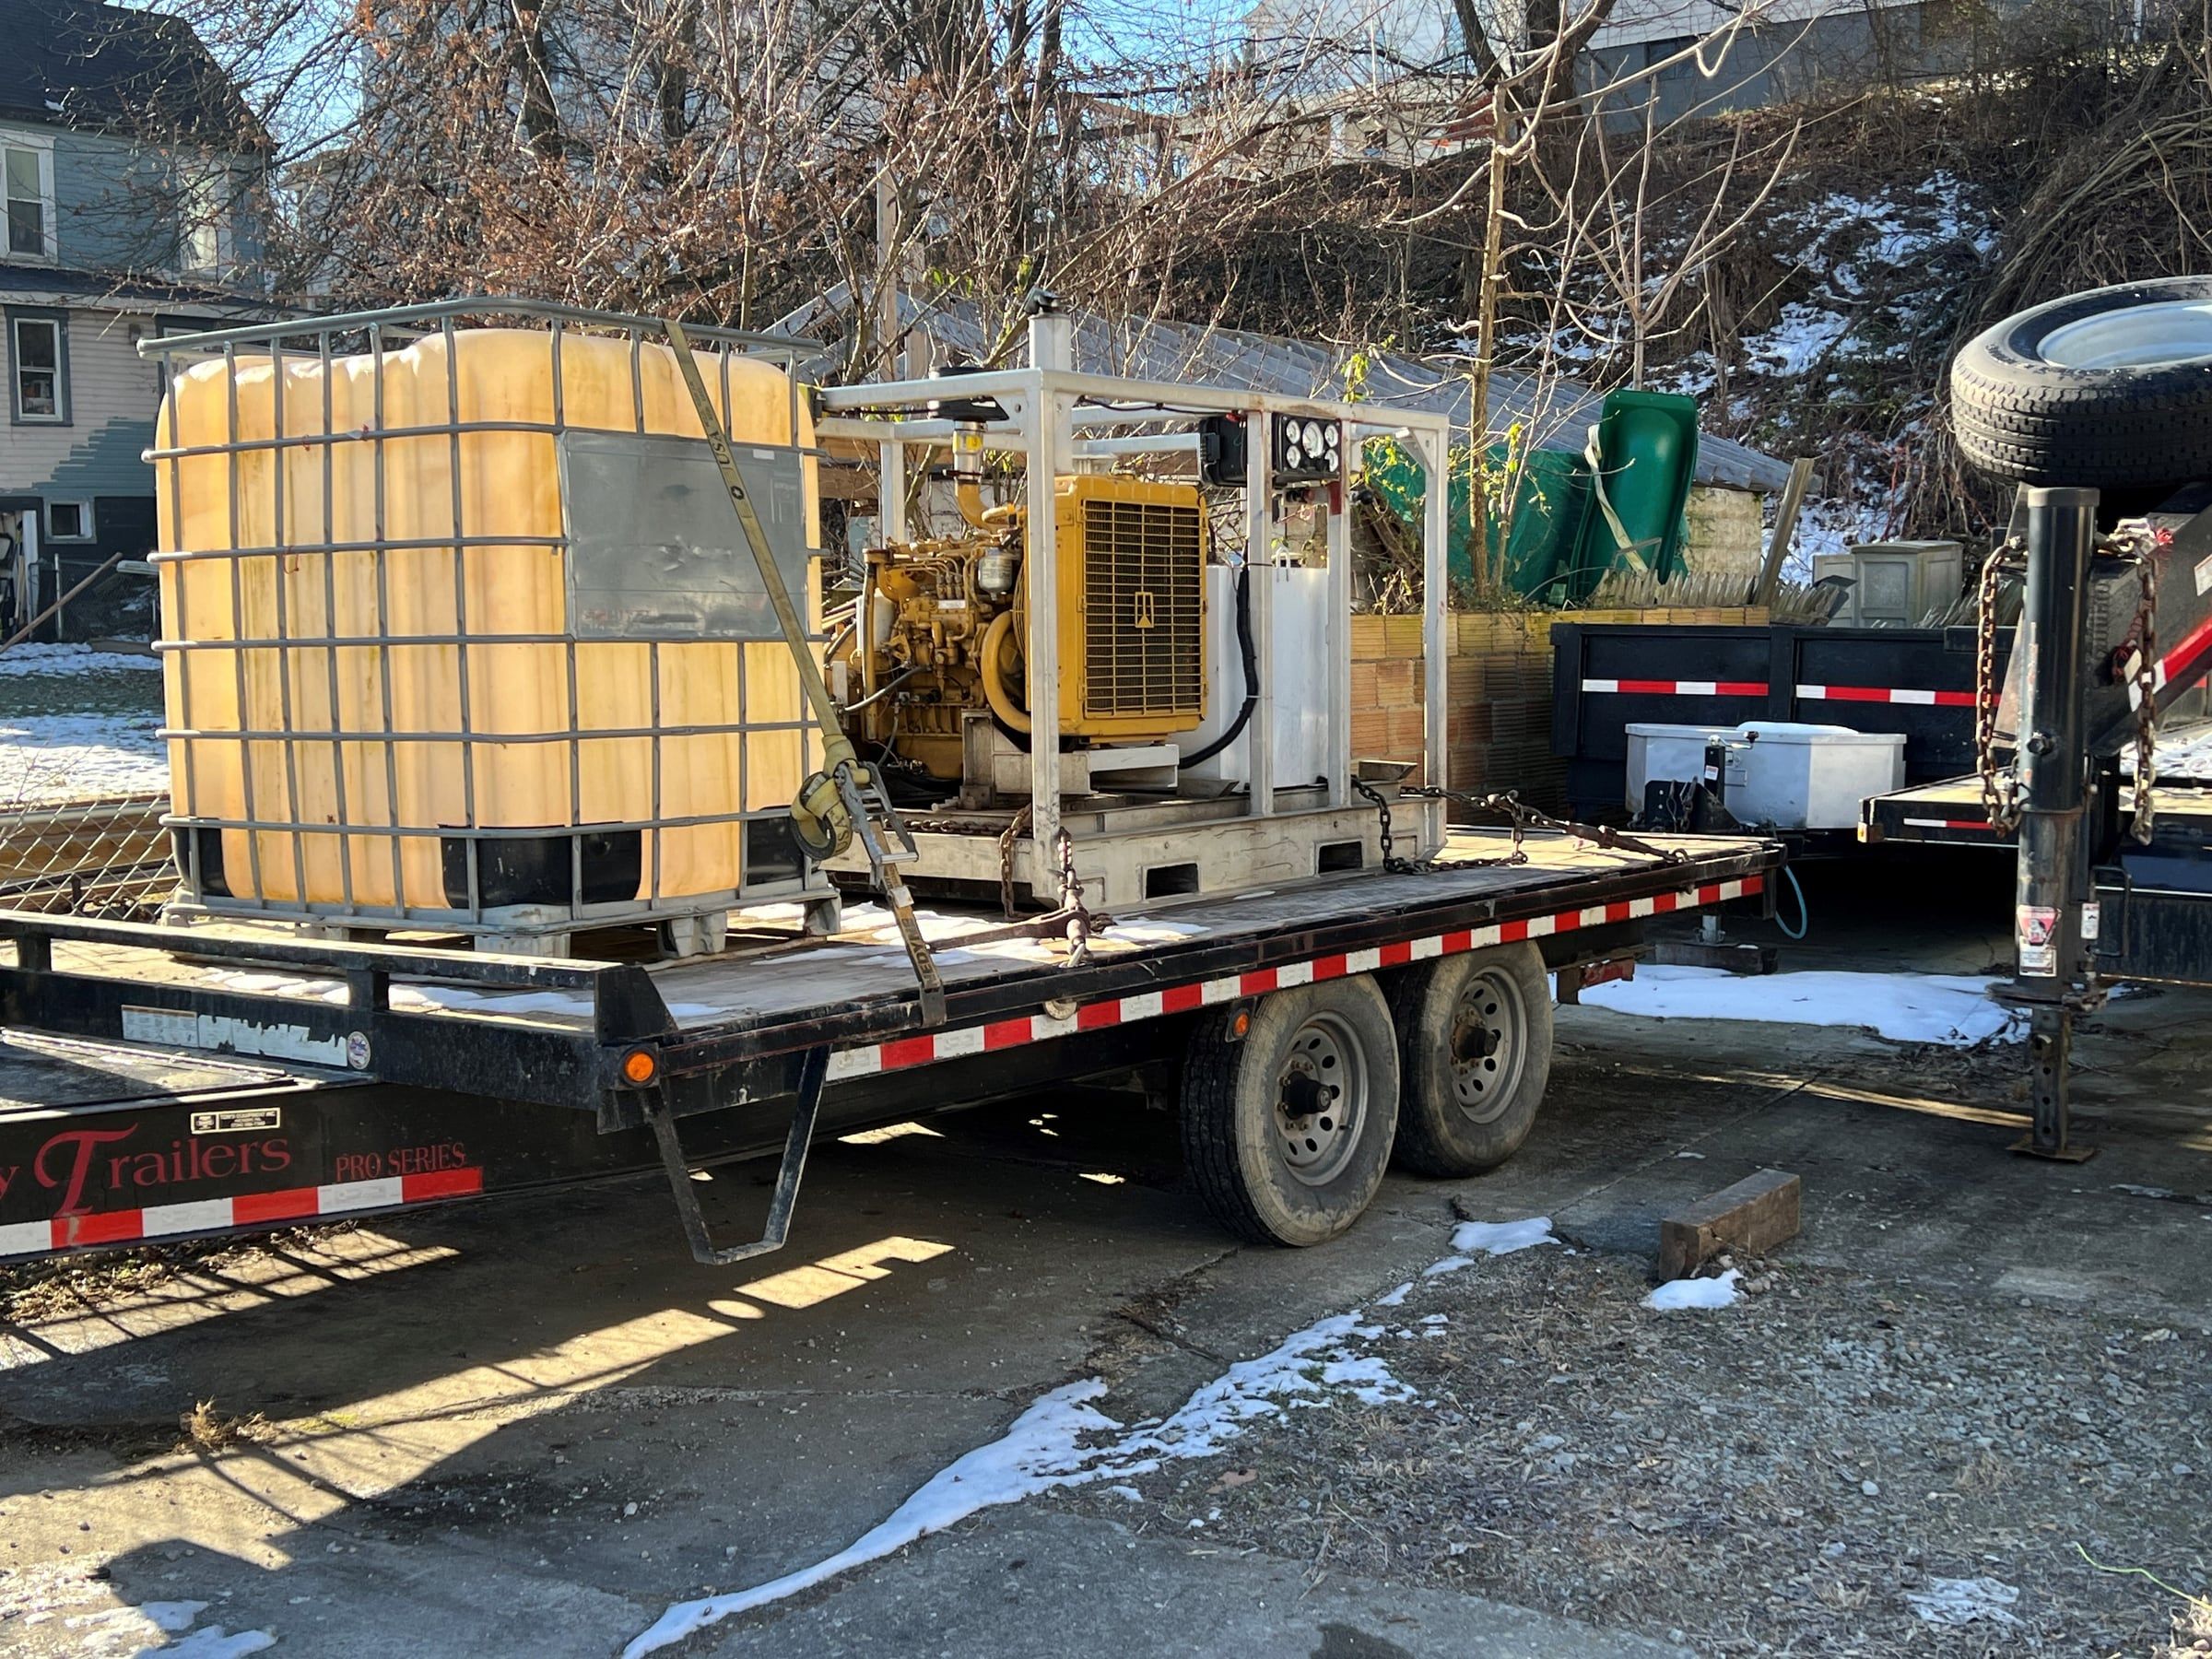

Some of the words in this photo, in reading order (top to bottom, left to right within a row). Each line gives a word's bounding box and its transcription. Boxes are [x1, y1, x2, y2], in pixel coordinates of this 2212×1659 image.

[709, 429, 730, 465] USA
[33, 1123, 291, 1218] Trailers
[335, 1151, 382, 1182] PRO
[388, 1142, 466, 1176] SERIES
